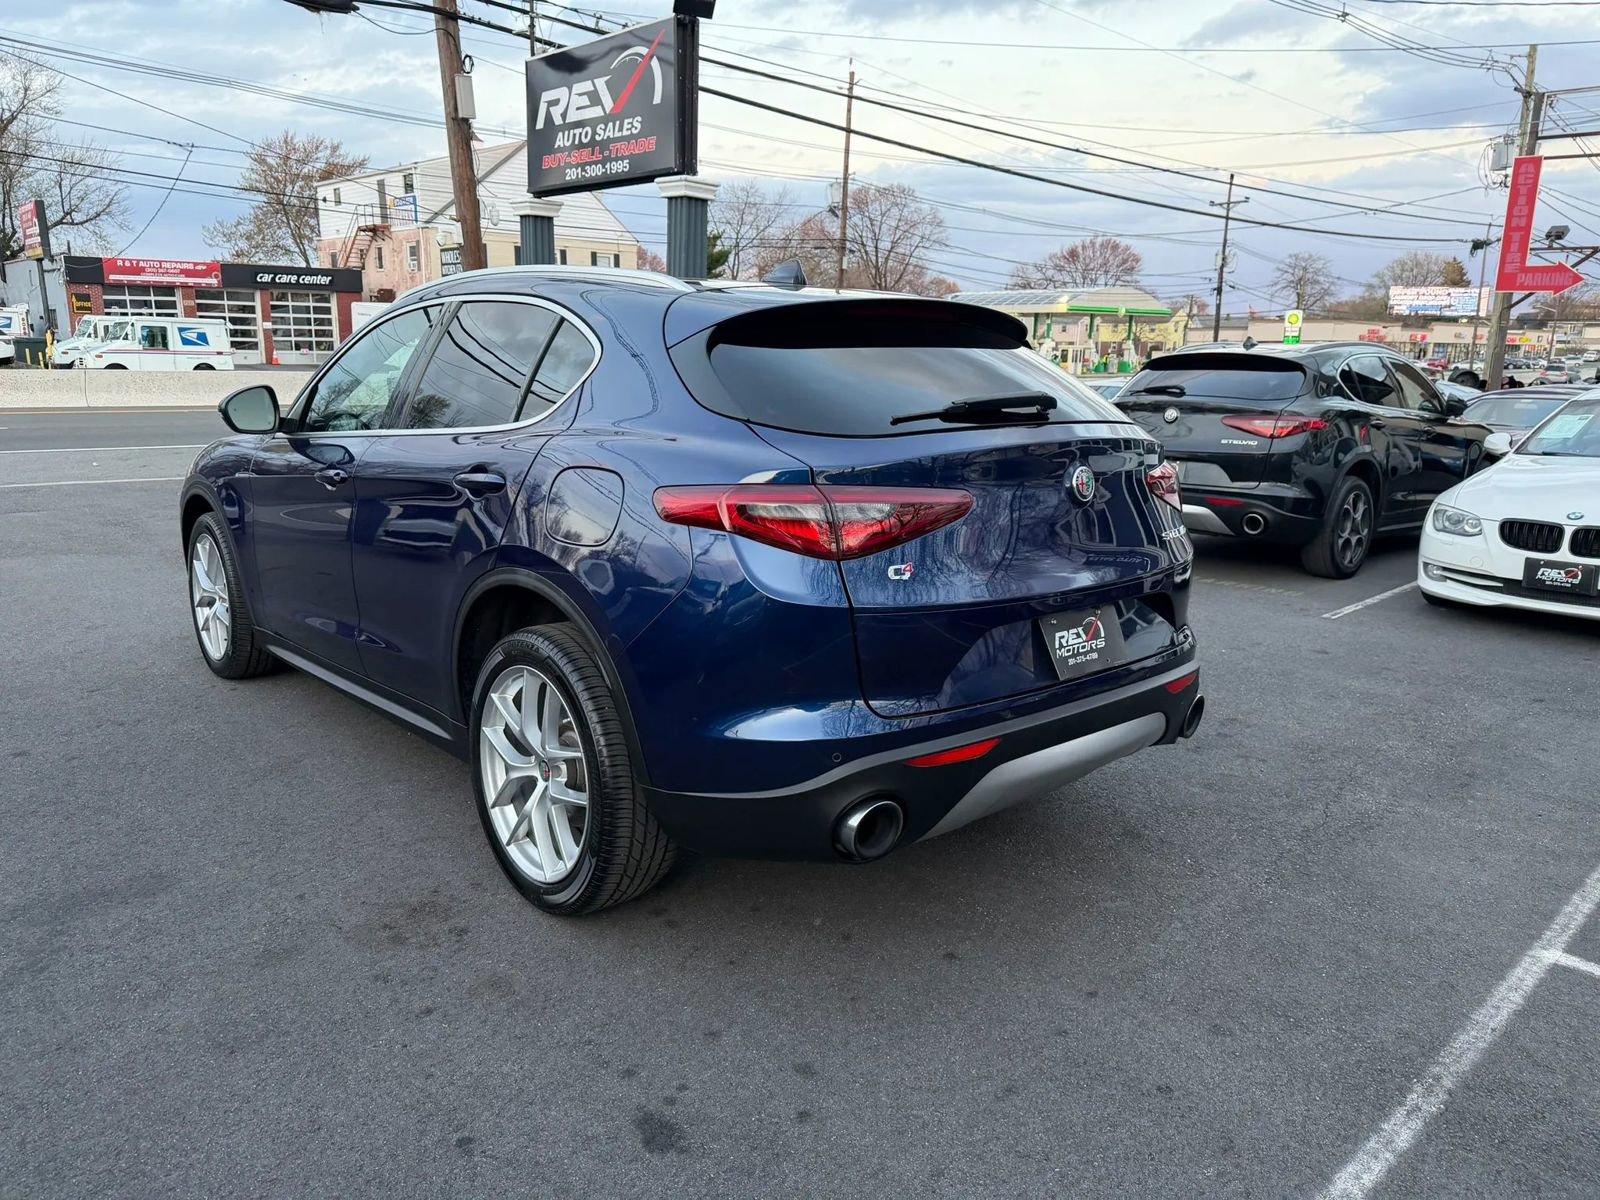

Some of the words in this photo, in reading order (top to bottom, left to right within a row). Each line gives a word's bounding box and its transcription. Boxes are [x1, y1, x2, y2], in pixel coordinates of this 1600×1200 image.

[536, 55, 648, 130] REV
[554, 126, 592, 149] AUTO
[595, 115, 642, 141] SALES
[565, 159, 630, 181] 201-300-1995
[1510, 162, 1536, 227] ACTION
[1503, 231, 1525, 273] TIRE
[139, 261, 161, 269] AUTO
[161, 262, 194, 270] REPAIRS
[256, 273, 274, 282] car
[275, 273, 298, 284] care
[299, 274, 332, 285] center
[1515, 272, 1575, 287] PARKING
[1220, 438, 1258, 446] STELVIO
[887, 562, 914, 581] Q4
[1535, 574, 1580, 584] MOTORS
[1055, 620, 1096, 649] REV
[1056, 638, 1106, 659] MOTORS
